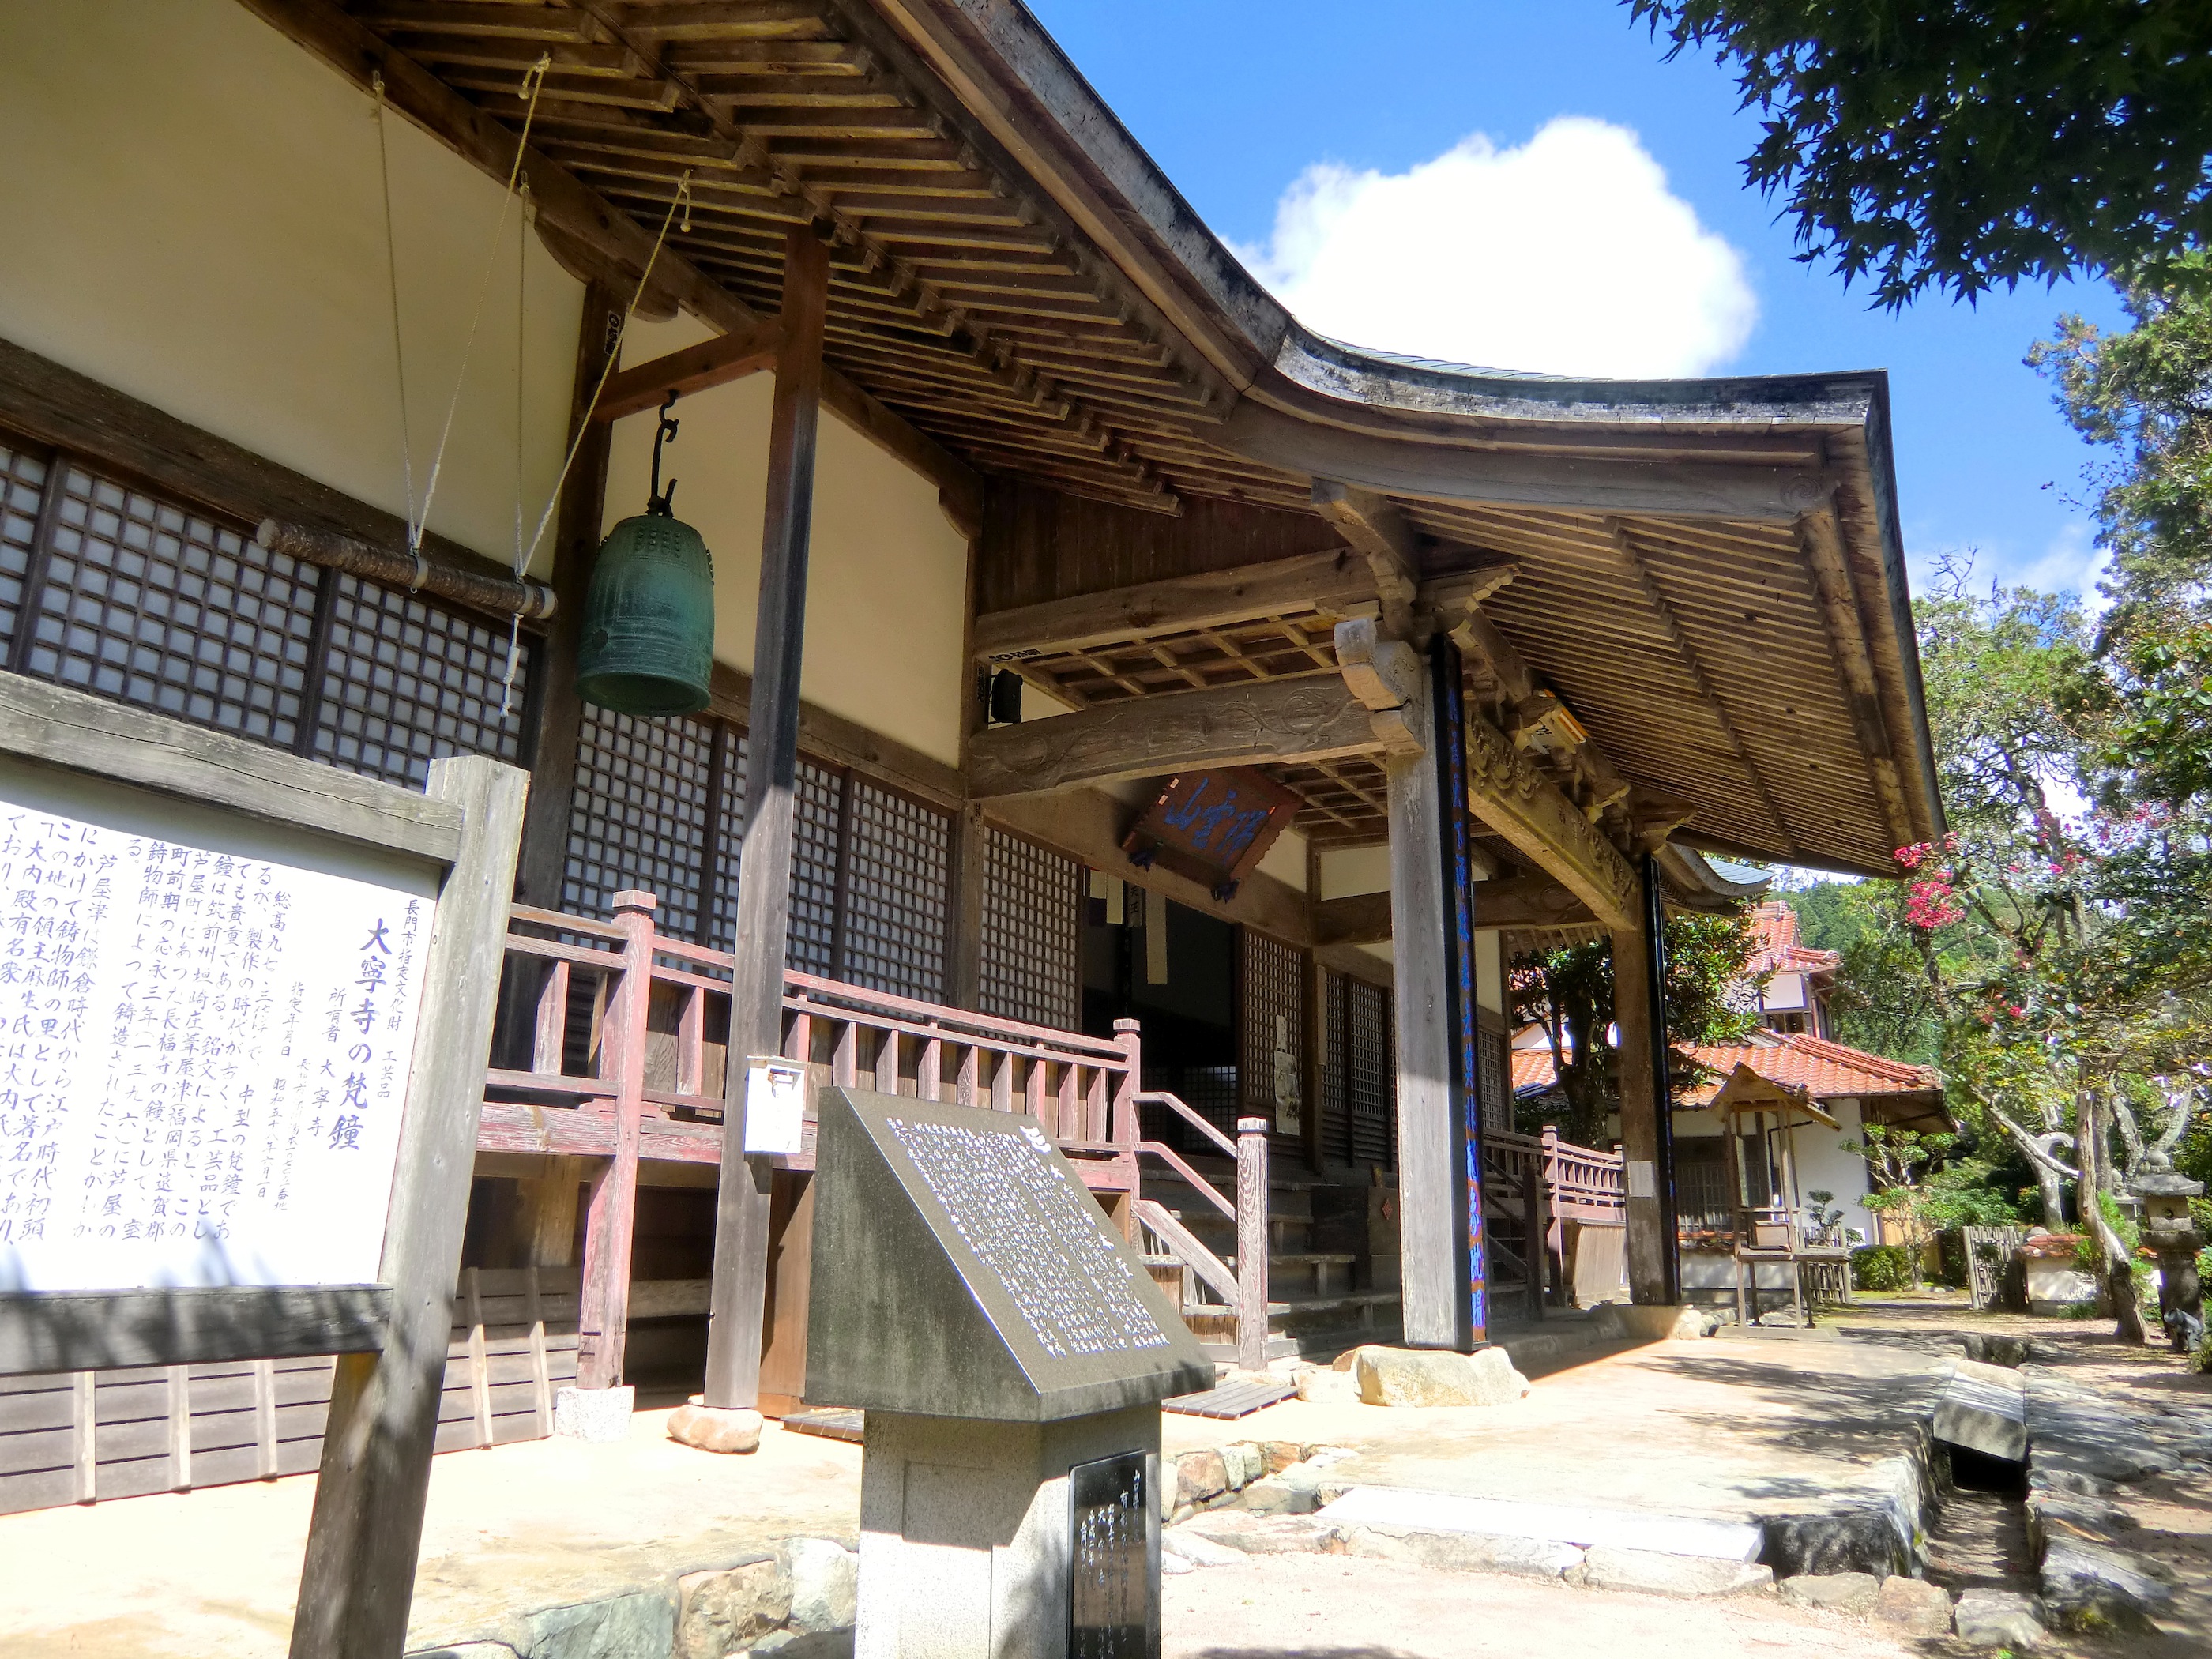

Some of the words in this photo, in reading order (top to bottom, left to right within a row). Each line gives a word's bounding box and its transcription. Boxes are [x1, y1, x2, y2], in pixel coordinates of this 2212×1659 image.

[126, 838, 142, 864] る。
[386, 898, 419, 1032] 長門市指定文化財
[280, 980, 306, 1058] 指定年月日
[322, 986, 348, 1044] 所有者
[327, 917, 393, 1152] 大寧寺の梵鐘
[377, 1050, 397, 1098] 工芸品
[256, 1078, 287, 1198] 昭和五十八年六月一日
